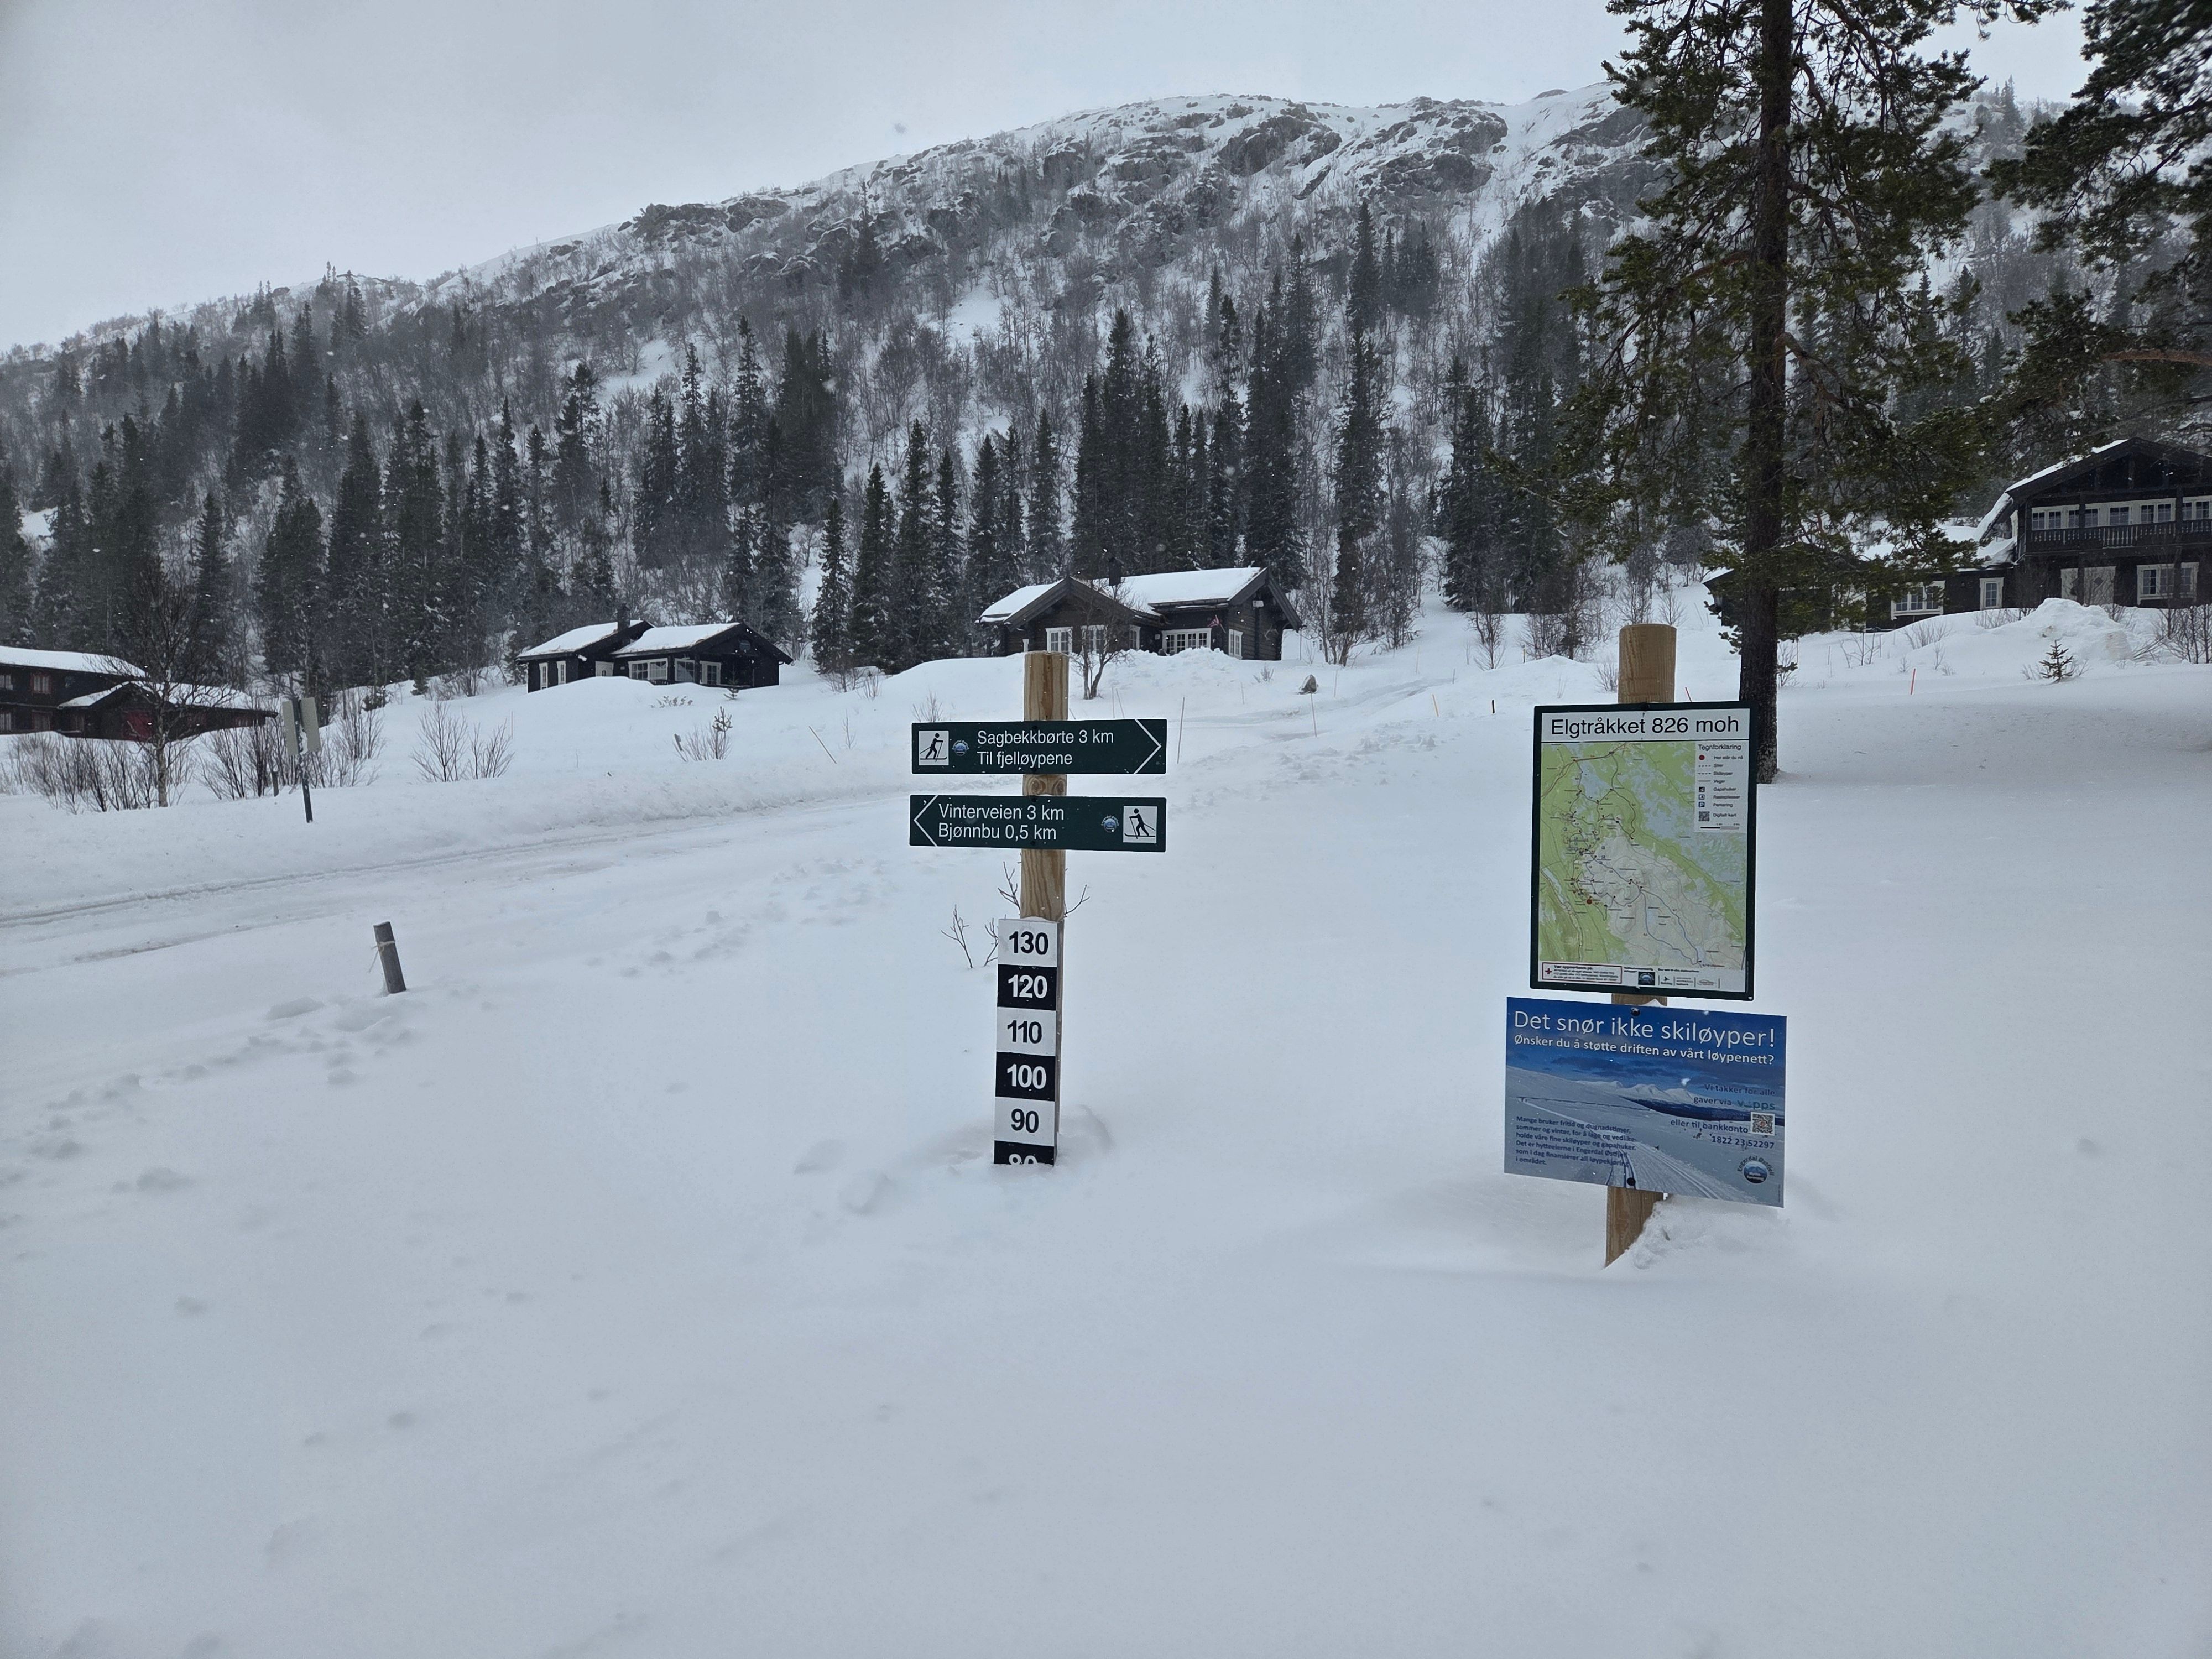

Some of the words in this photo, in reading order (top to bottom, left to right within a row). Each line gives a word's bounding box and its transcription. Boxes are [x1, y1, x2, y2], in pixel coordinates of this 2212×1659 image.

[1552, 717, 1646, 739] Elgtråkket
[1652, 717, 1688, 733] 826
[1695, 716, 1739, 732] moh
[977, 729, 1074, 747] Sagbekkbørte
[1079, 730, 1088, 743] 3
[1093, 729, 1114, 743] km
[977, 751, 993, 765] Til
[997, 751, 1072, 769] fjelløypene
[938, 803, 1022, 820] Vinterveien
[1027, 806, 1037, 820] 3
[1042, 805, 1064, 821] km
[938, 822, 1000, 841] Bjønnbu
[1005, 825, 1029, 842] 0,5
[1034, 825, 1056, 840] km
[1009, 931, 1048, 956] 130
[1008, 974, 1048, 999] 120
[1007, 1020, 1042, 1044] 110
[1515, 1011, 1551, 1030] Det
[1557, 1018, 1604, 1034] snør
[1611, 1017, 1653, 1038] ikke
[1661, 1021, 1774, 1048] skiløyper!
[1514, 1034, 1553, 1046] Ønsker
[1556, 1038, 1570, 1048] du
[1574, 1039, 1580, 1048] å
[1583, 1041, 1617, 1051] støtte
[1620, 1043, 1659, 1055] driften
[1680, 1048, 1704, 1060] vårt
[1708, 1050, 1774, 1065] løypenett?
[1006, 1064, 1047, 1089] 100
[1011, 1108, 1039, 1133] 90
[1671, 1119, 1689, 1127] eller
[1703, 1122, 1749, 1134] bankkonto
[1563, 1137, 1590, 1145] skiløyper
[1712, 1136, 1732, 1145] 1822
[1748, 1140, 1775, 1149] 52297
[1546, 1151, 1579, 1161] finansierer
[1737, 1156, 1757, 1172] Engerdal
